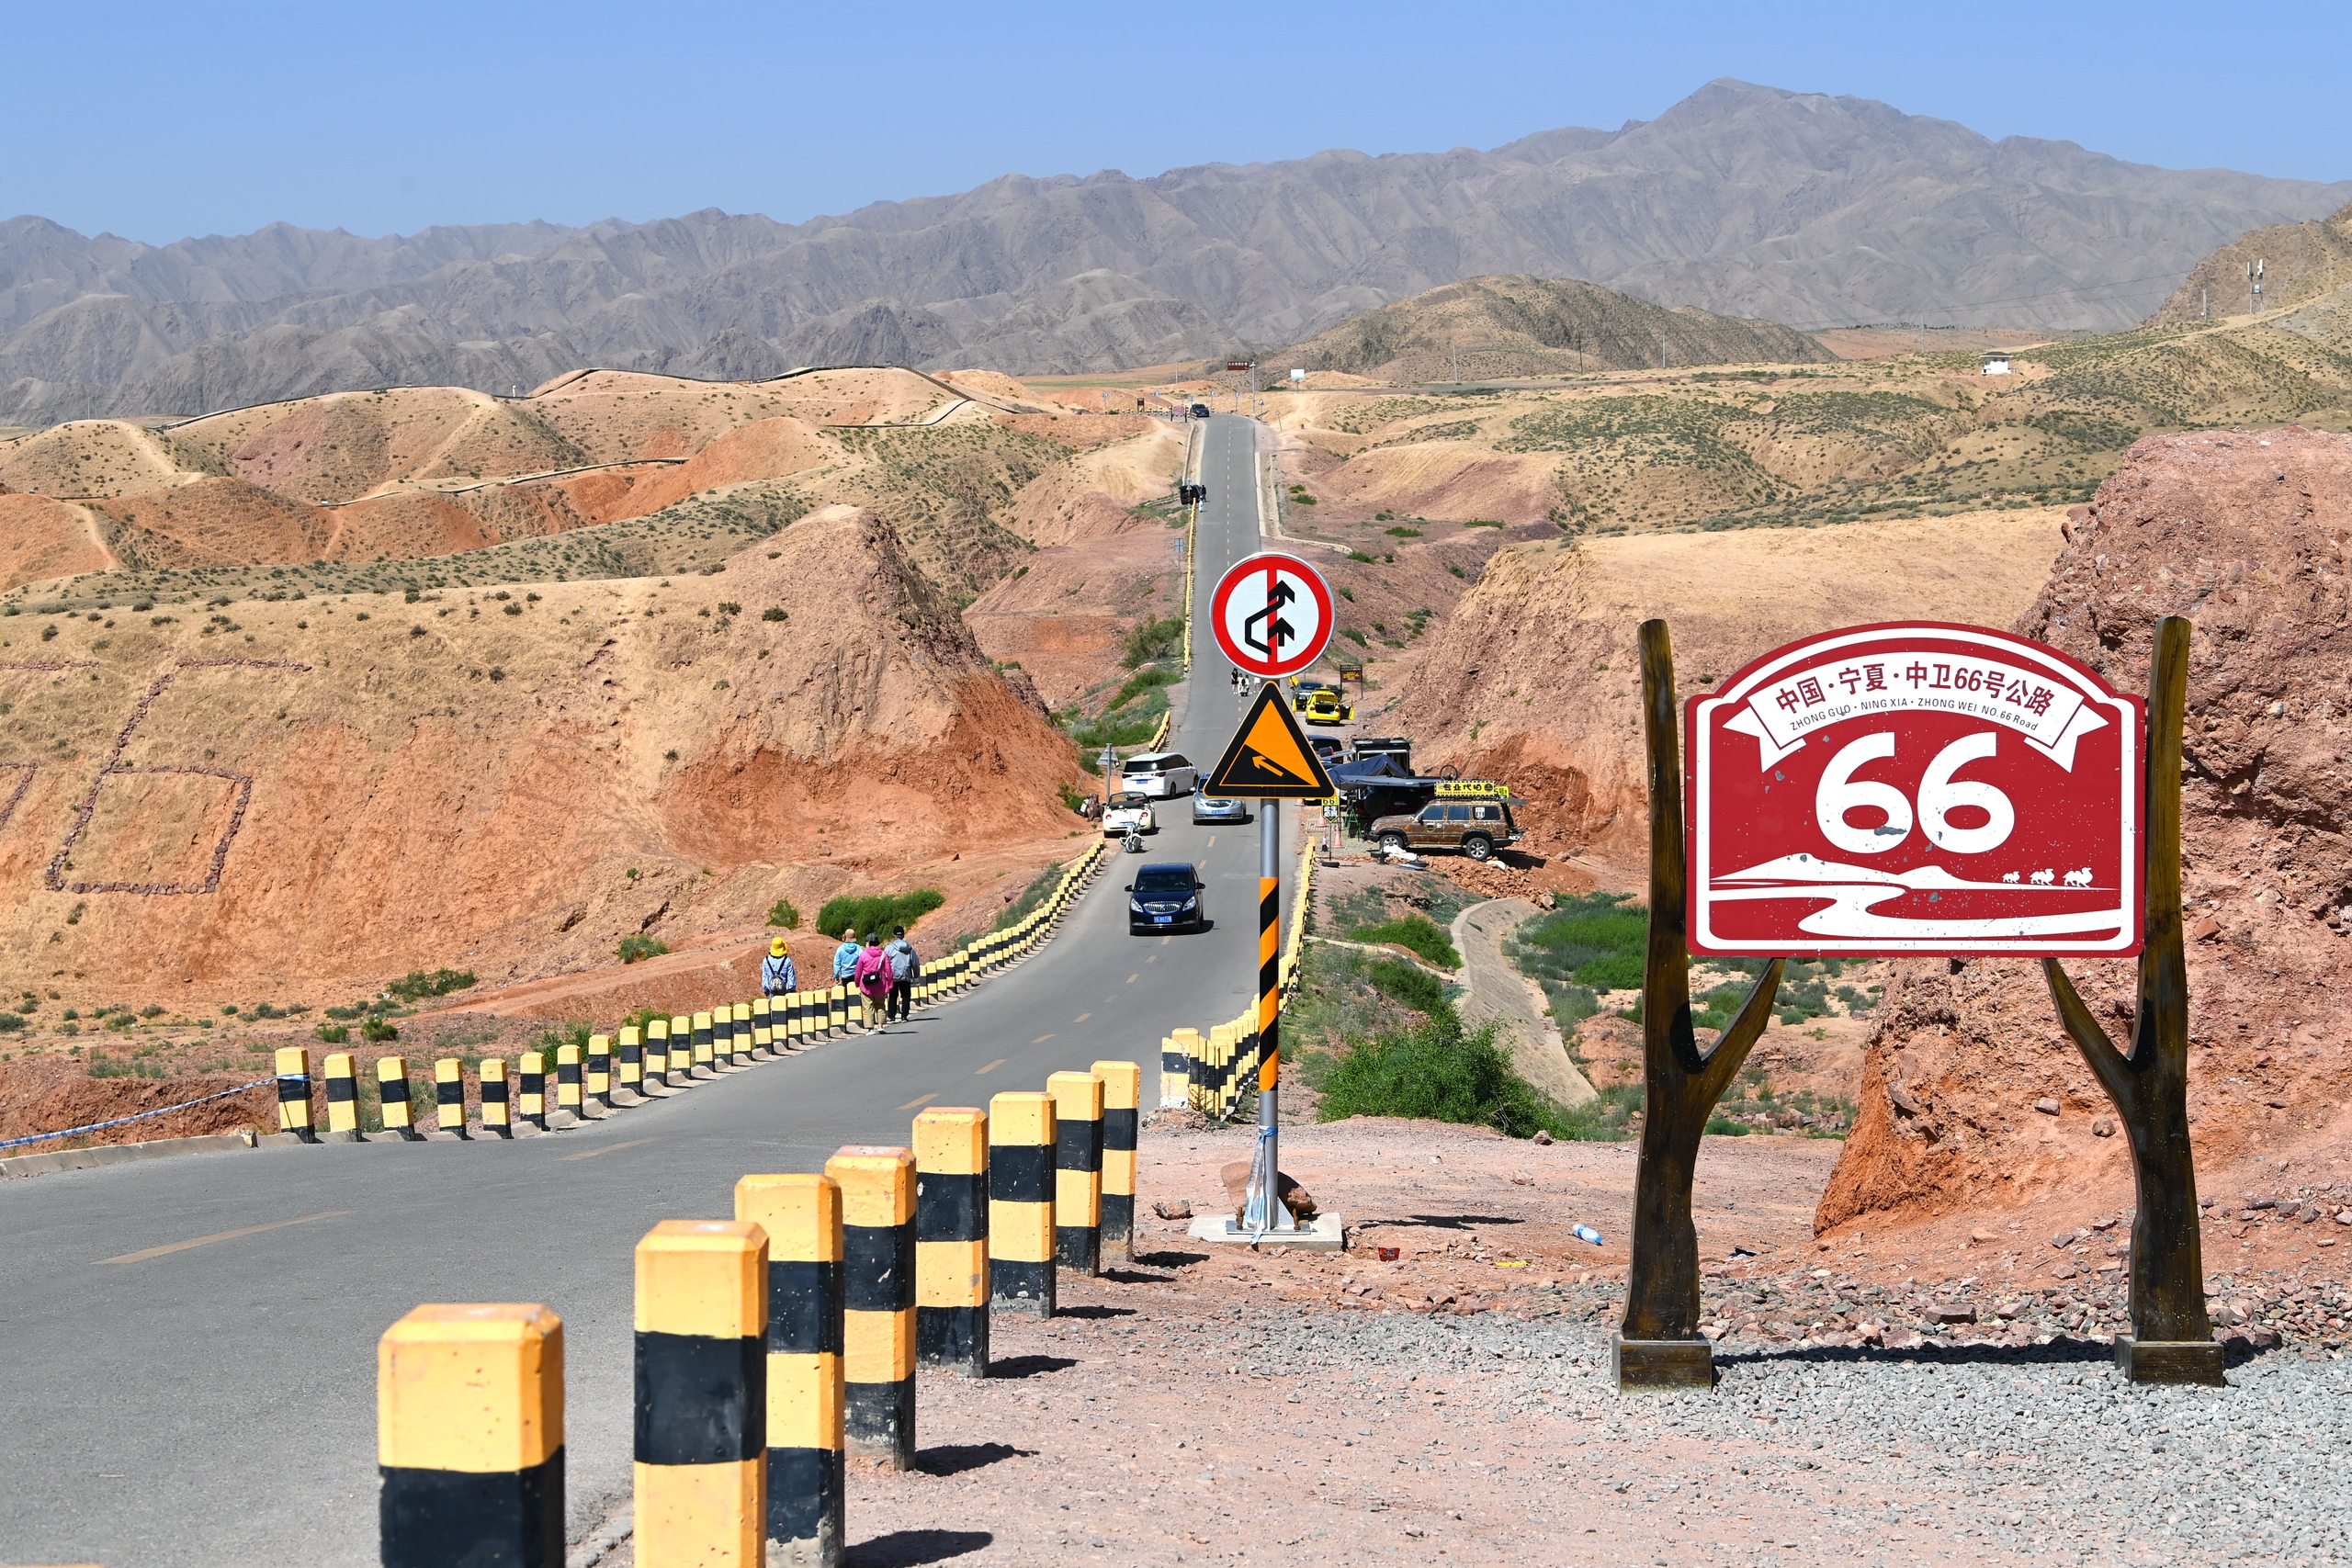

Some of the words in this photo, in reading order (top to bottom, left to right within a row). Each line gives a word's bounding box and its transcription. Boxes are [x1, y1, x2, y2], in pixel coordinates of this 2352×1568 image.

[1790, 711, 1826, 731] ZHONG
[1828, 705, 1851, 717] GUO
[1860, 699, 1887, 711] NING
[1890, 698, 1908, 707] XIA
[1917, 698, 1955, 709] ZHONG
[1958, 701, 1978, 713] WEI
[2012, 715, 2039, 731] Road
[1815, 731, 2016, 854] 66
